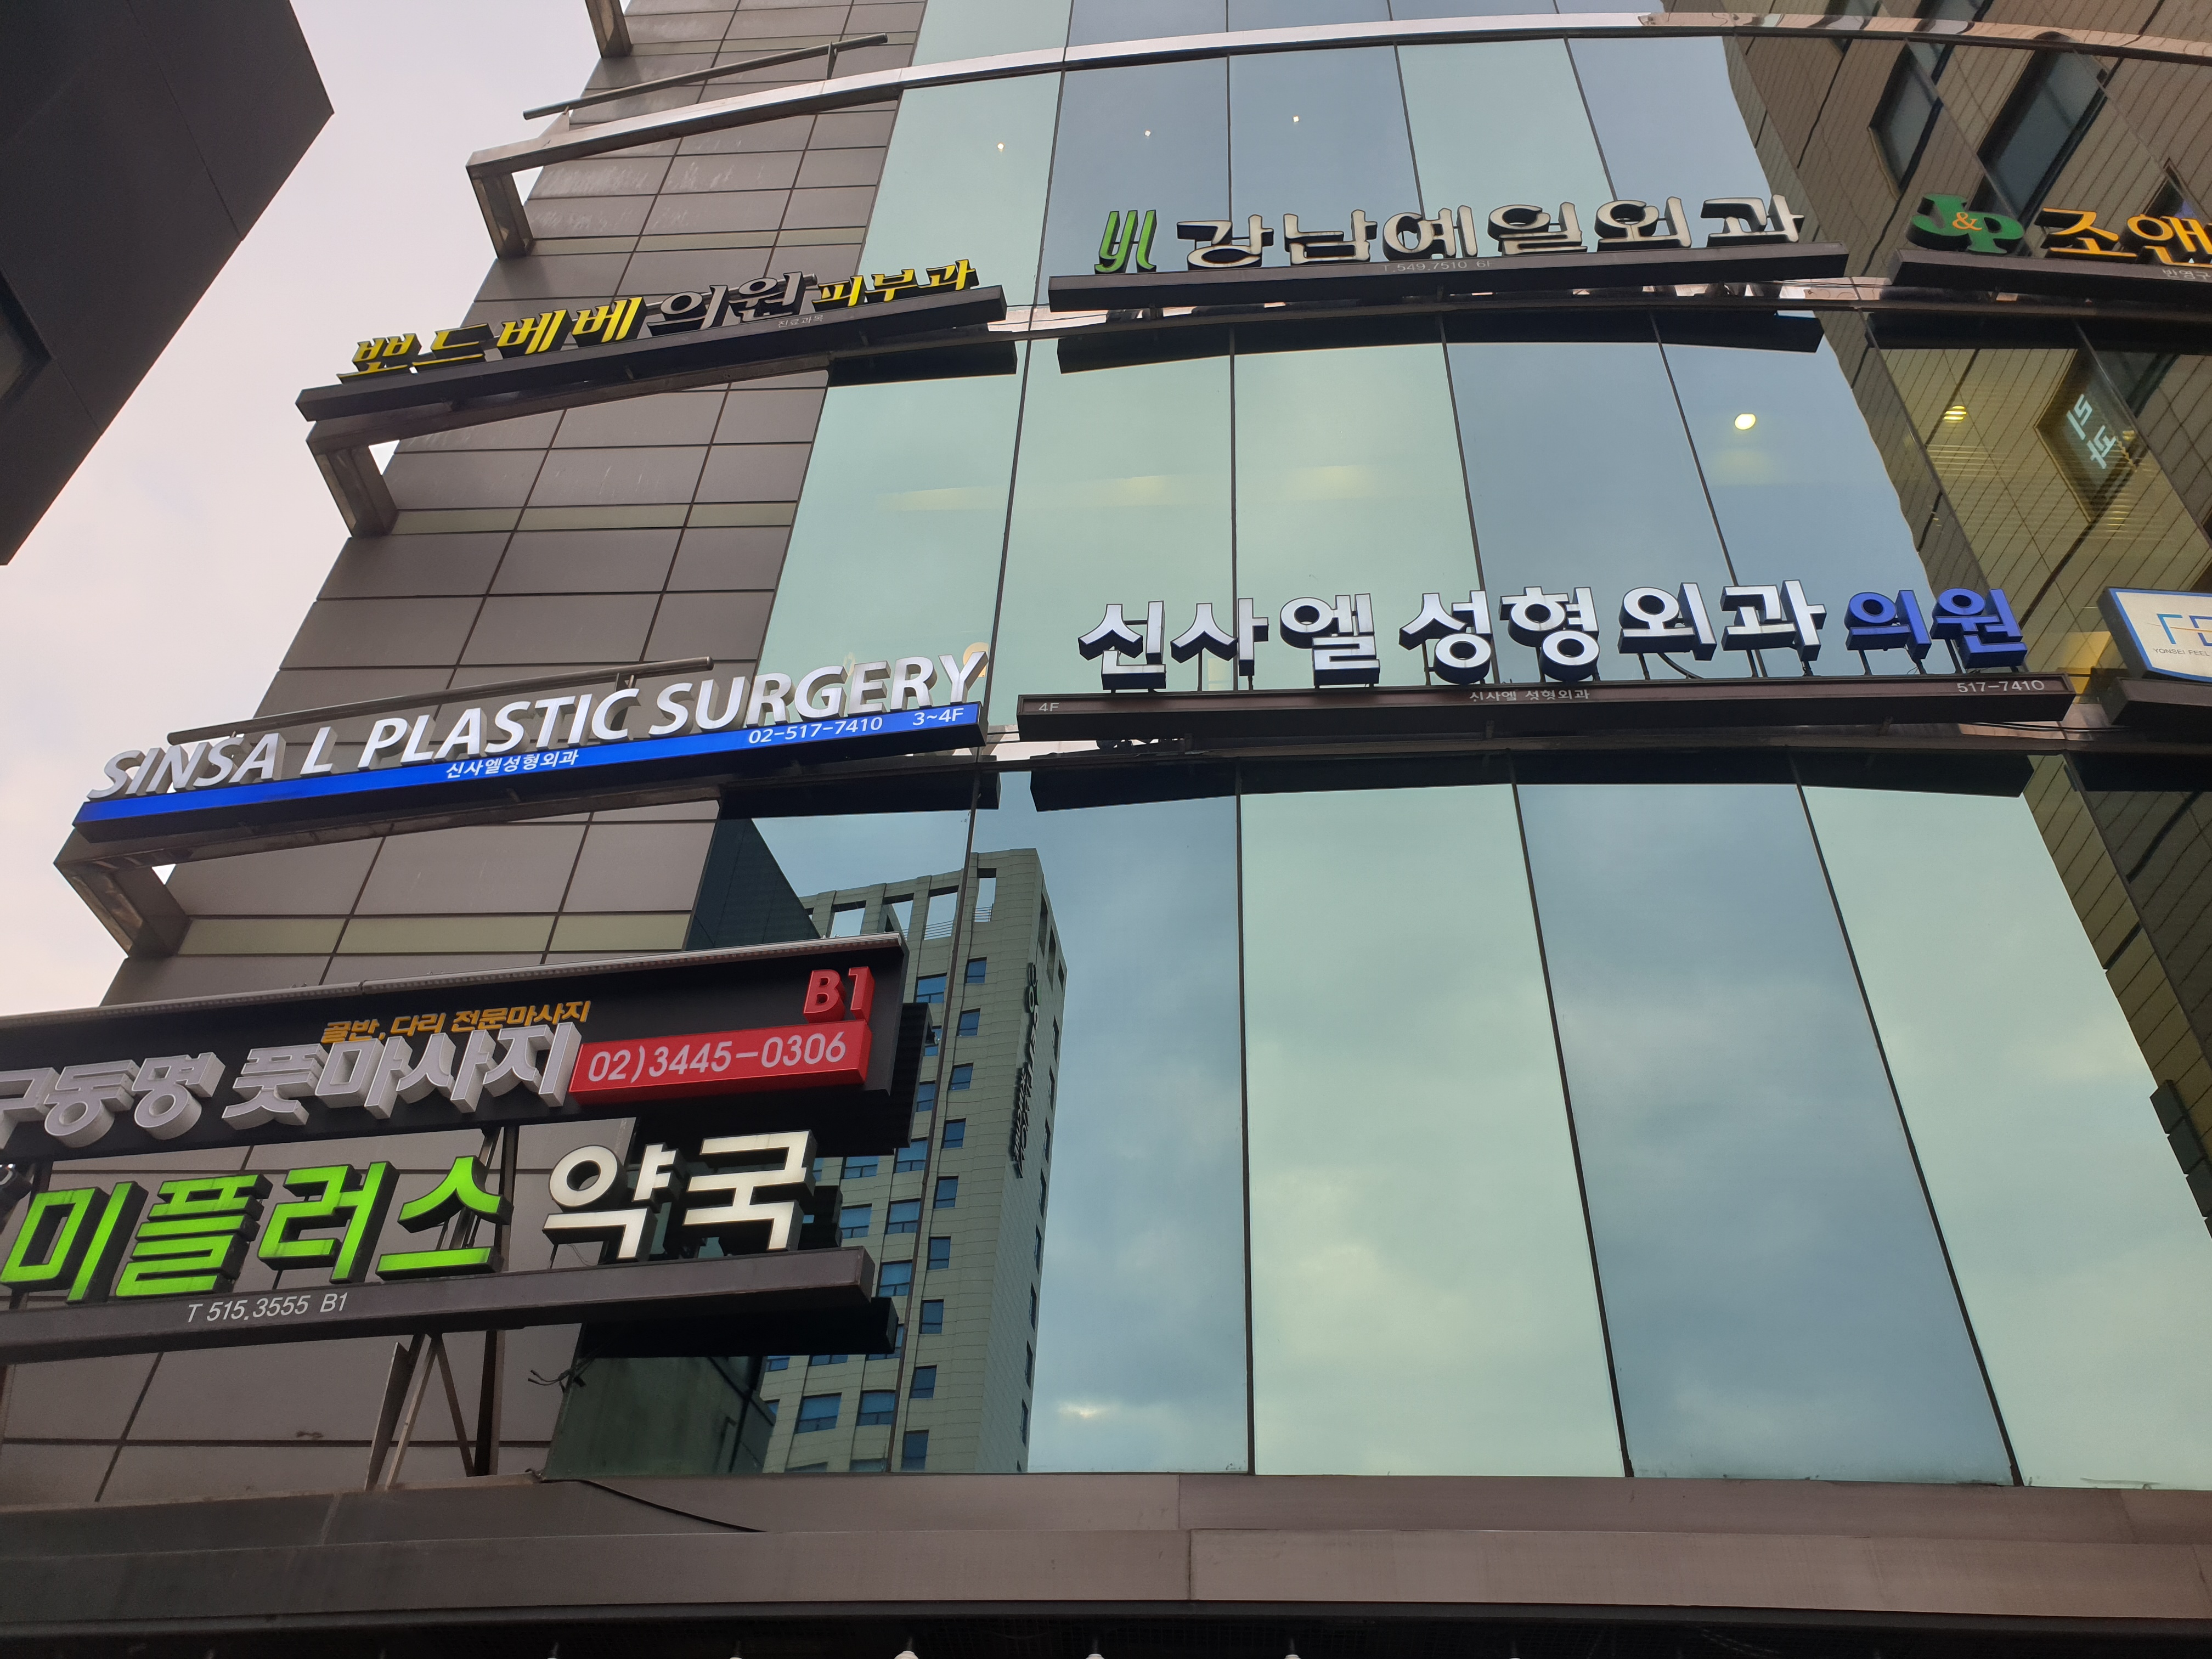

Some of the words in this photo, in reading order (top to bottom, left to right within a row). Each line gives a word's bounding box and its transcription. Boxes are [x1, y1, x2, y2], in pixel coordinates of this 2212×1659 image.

[1910, 193, 2024, 254] J&P
[777, 314, 823, 328] 진료과목
[1956, 680, 2045, 693] 517-7410
[87, 733, 281, 799] SINSA
[358, 688, 640, 769] PLASTIC
[648, 651, 988, 736] SURGERY
[1039, 702, 1060, 712] 4F
[748, 716, 883, 744] 02-517-7410
[912, 707, 964, 726] 3~4F
[445, 749, 579, 779] 신사엘성형외과
[803, 966, 872, 1019] B1
[390, 1012, 447, 1036] 다리
[452, 1001, 591, 1032] 전문마사지
[588, 1031, 847, 1084] 02)3445-0306
[0, 1156, 507, 1302] 미플러스
[543, 1130, 813, 1260] 약국
[187, 1304, 203, 1323] T
[207, 1295, 311, 1322] 515.3555
[319, 1293, 348, 1313] B1
